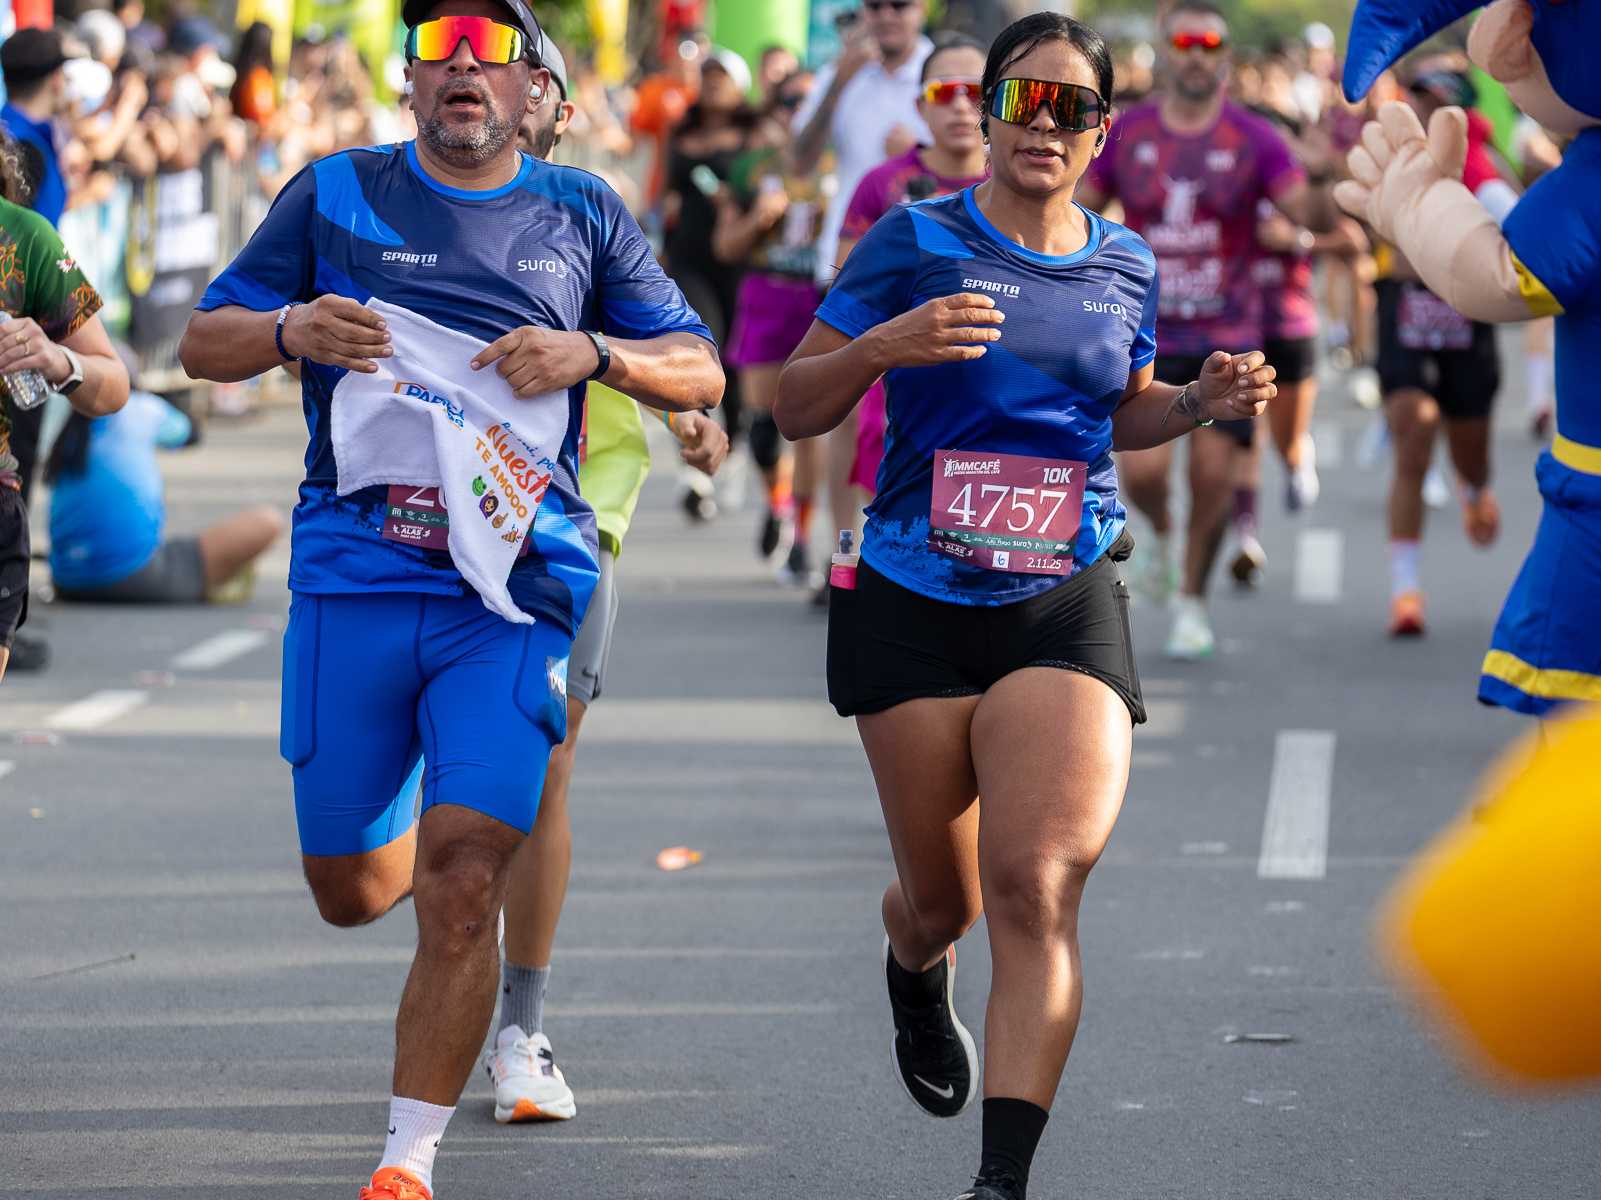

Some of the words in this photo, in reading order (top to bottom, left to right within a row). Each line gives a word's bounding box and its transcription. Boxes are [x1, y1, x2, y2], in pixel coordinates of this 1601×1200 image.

[382, 251, 438, 264] SPARTA
[962, 278, 1021, 296] SPARTA
[475, 435, 493, 464] TE
[489, 463, 528, 519] AMOOO
[1043, 468, 1073, 484] 10K
[947, 483, 1068, 534] 4757
[1027, 557, 1062, 570] 2.11.25
